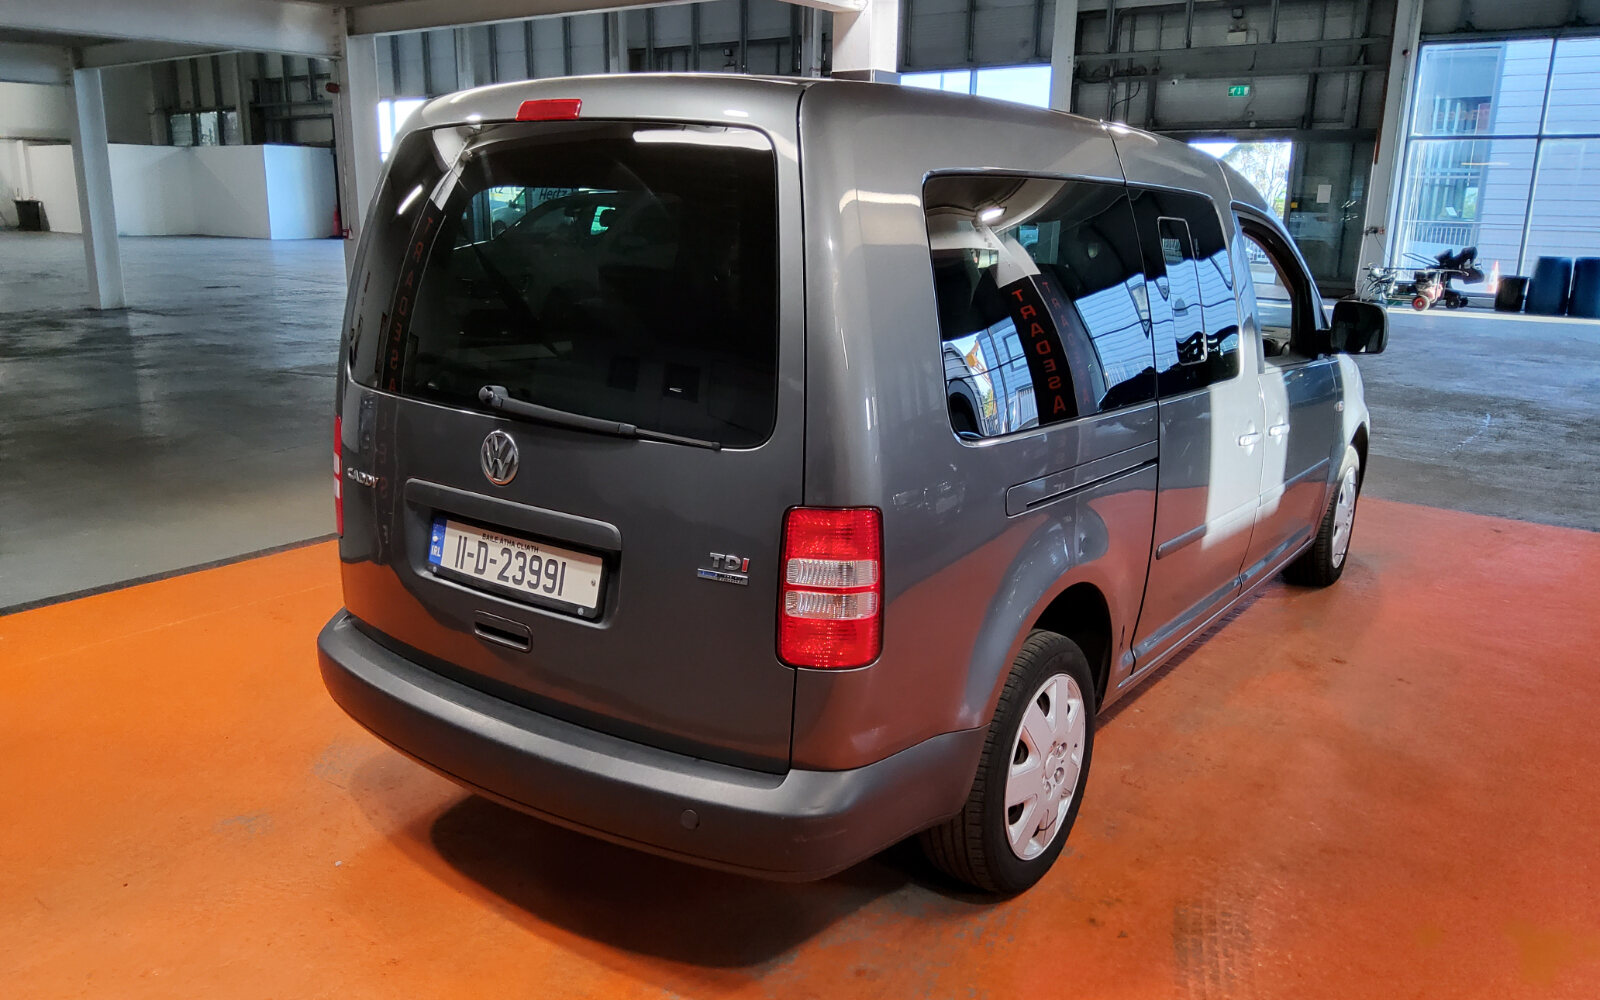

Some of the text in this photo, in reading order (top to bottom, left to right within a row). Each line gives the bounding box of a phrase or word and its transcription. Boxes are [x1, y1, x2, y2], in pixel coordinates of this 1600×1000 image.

[347, 467, 379, 488] CADDY
[431, 545, 441, 557] IRL
[455, 535, 567, 596] 11-D-23991
[709, 552, 750, 573] TDI
